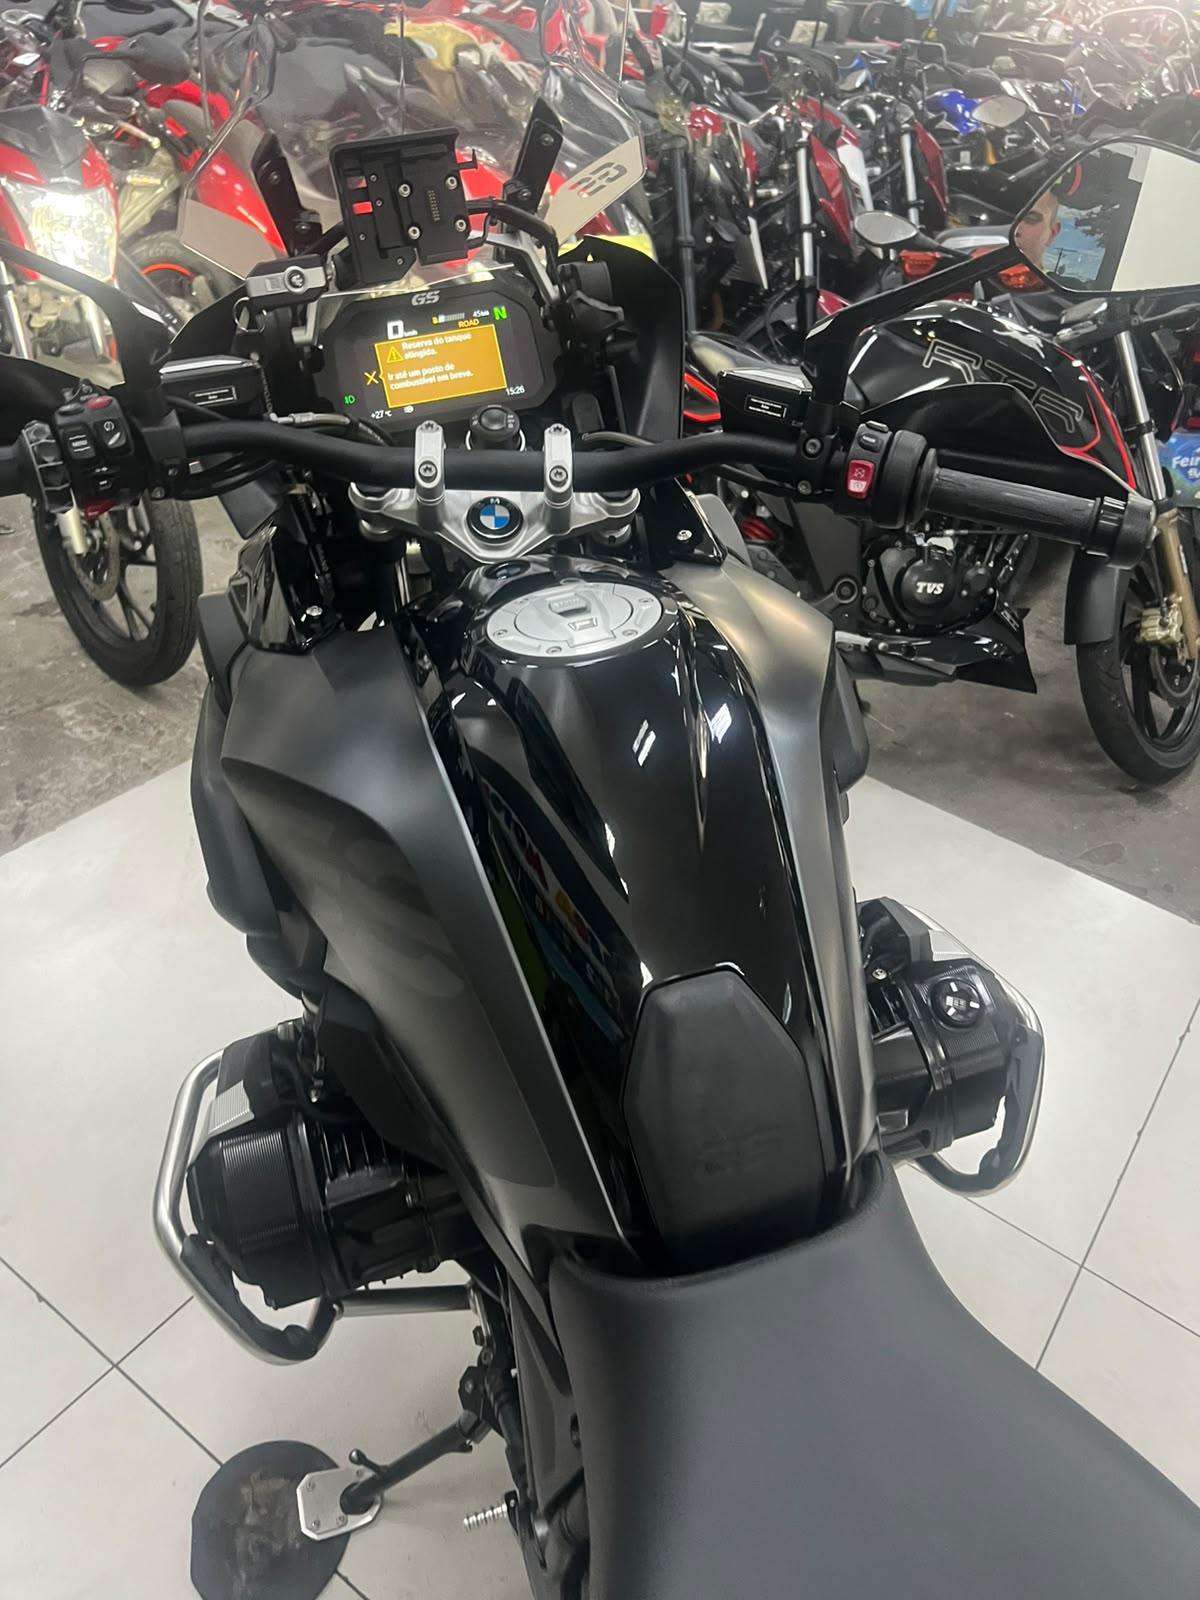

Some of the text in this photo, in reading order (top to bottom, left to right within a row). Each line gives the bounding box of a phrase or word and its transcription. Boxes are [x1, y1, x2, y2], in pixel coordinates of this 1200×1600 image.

[411, 290, 440, 306] GS
[492, 305, 507, 320] N
[387, 320, 404, 340] 0
[458, 318, 479, 328] ROAD
[402, 332, 472, 351] Reserva do tanque
[404, 348, 438, 360] atingida.
[387, 362, 455, 381] Ir até um posto de
[389, 370, 474, 390] combustível em breve.
[506, 385, 526, 396] 15:26
[916, 582, 944, 595] TVS
